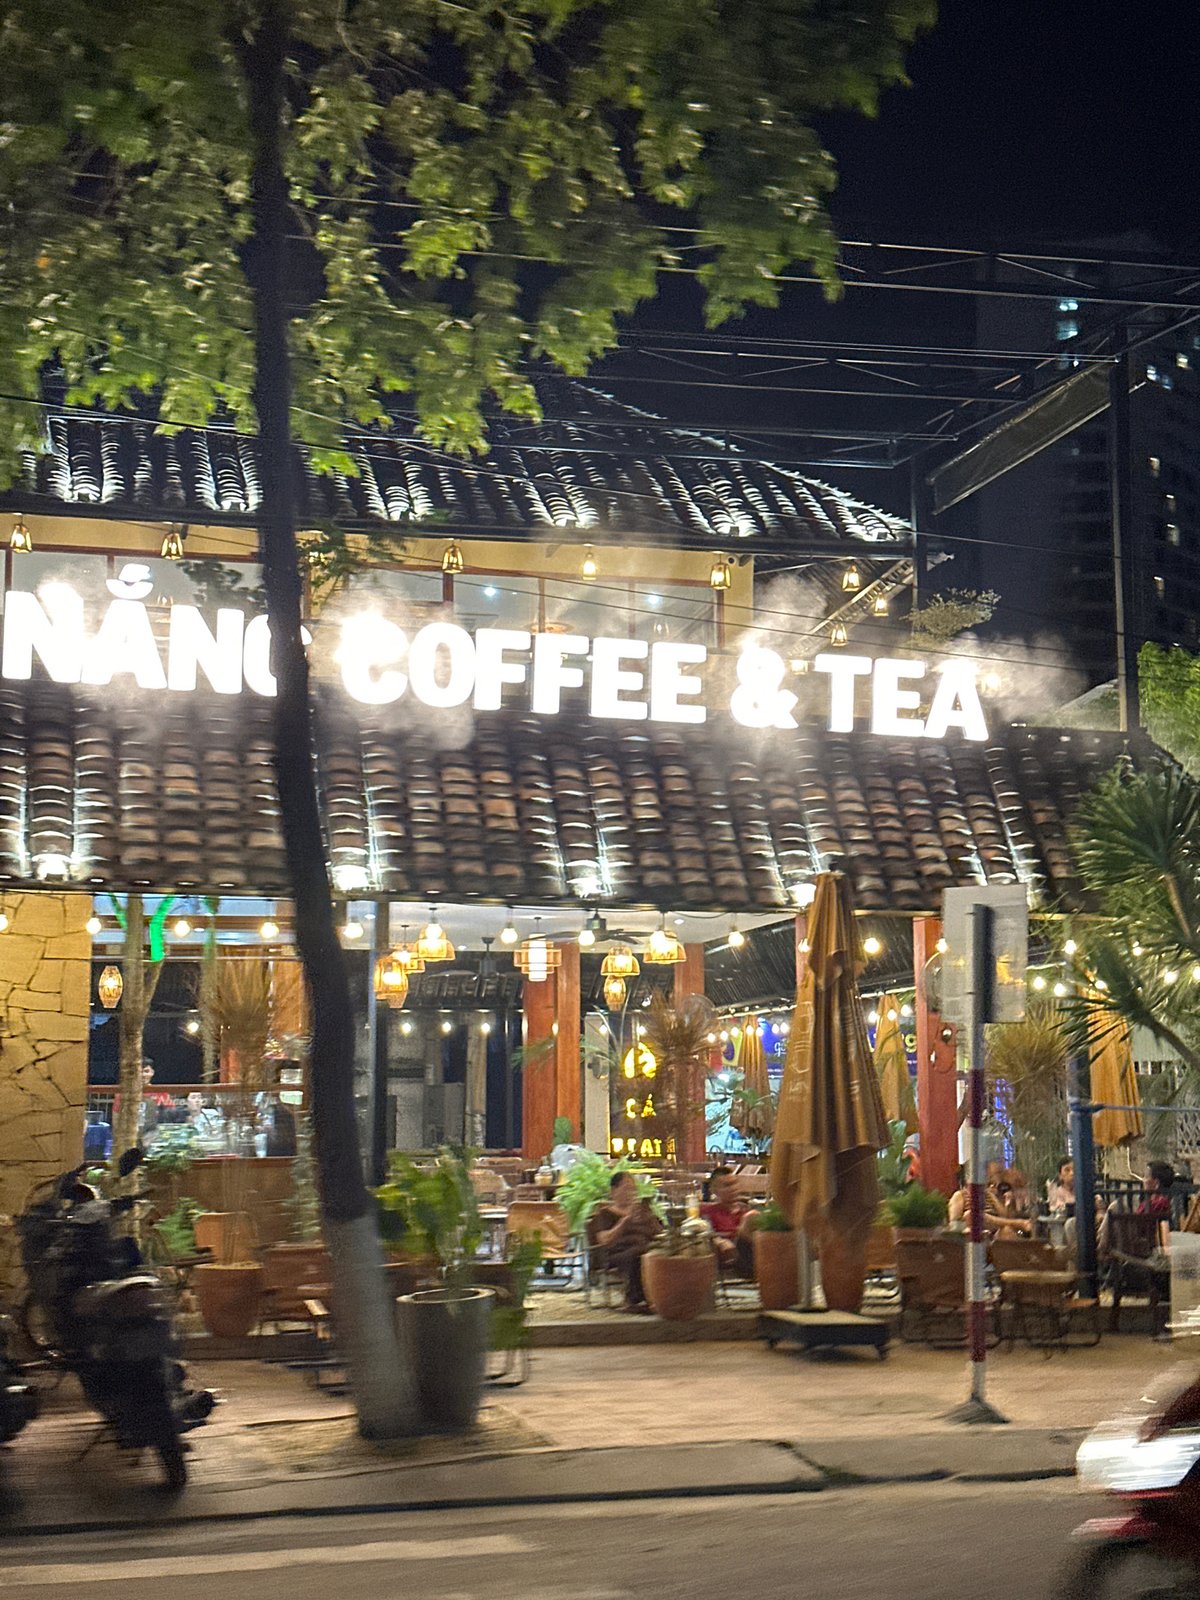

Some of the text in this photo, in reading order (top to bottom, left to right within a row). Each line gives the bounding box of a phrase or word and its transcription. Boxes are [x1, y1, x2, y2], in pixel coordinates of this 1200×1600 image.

[340, 614, 707, 724] COFFEE
[730, 648, 799, 729] &
[814, 653, 990, 742] TEA
